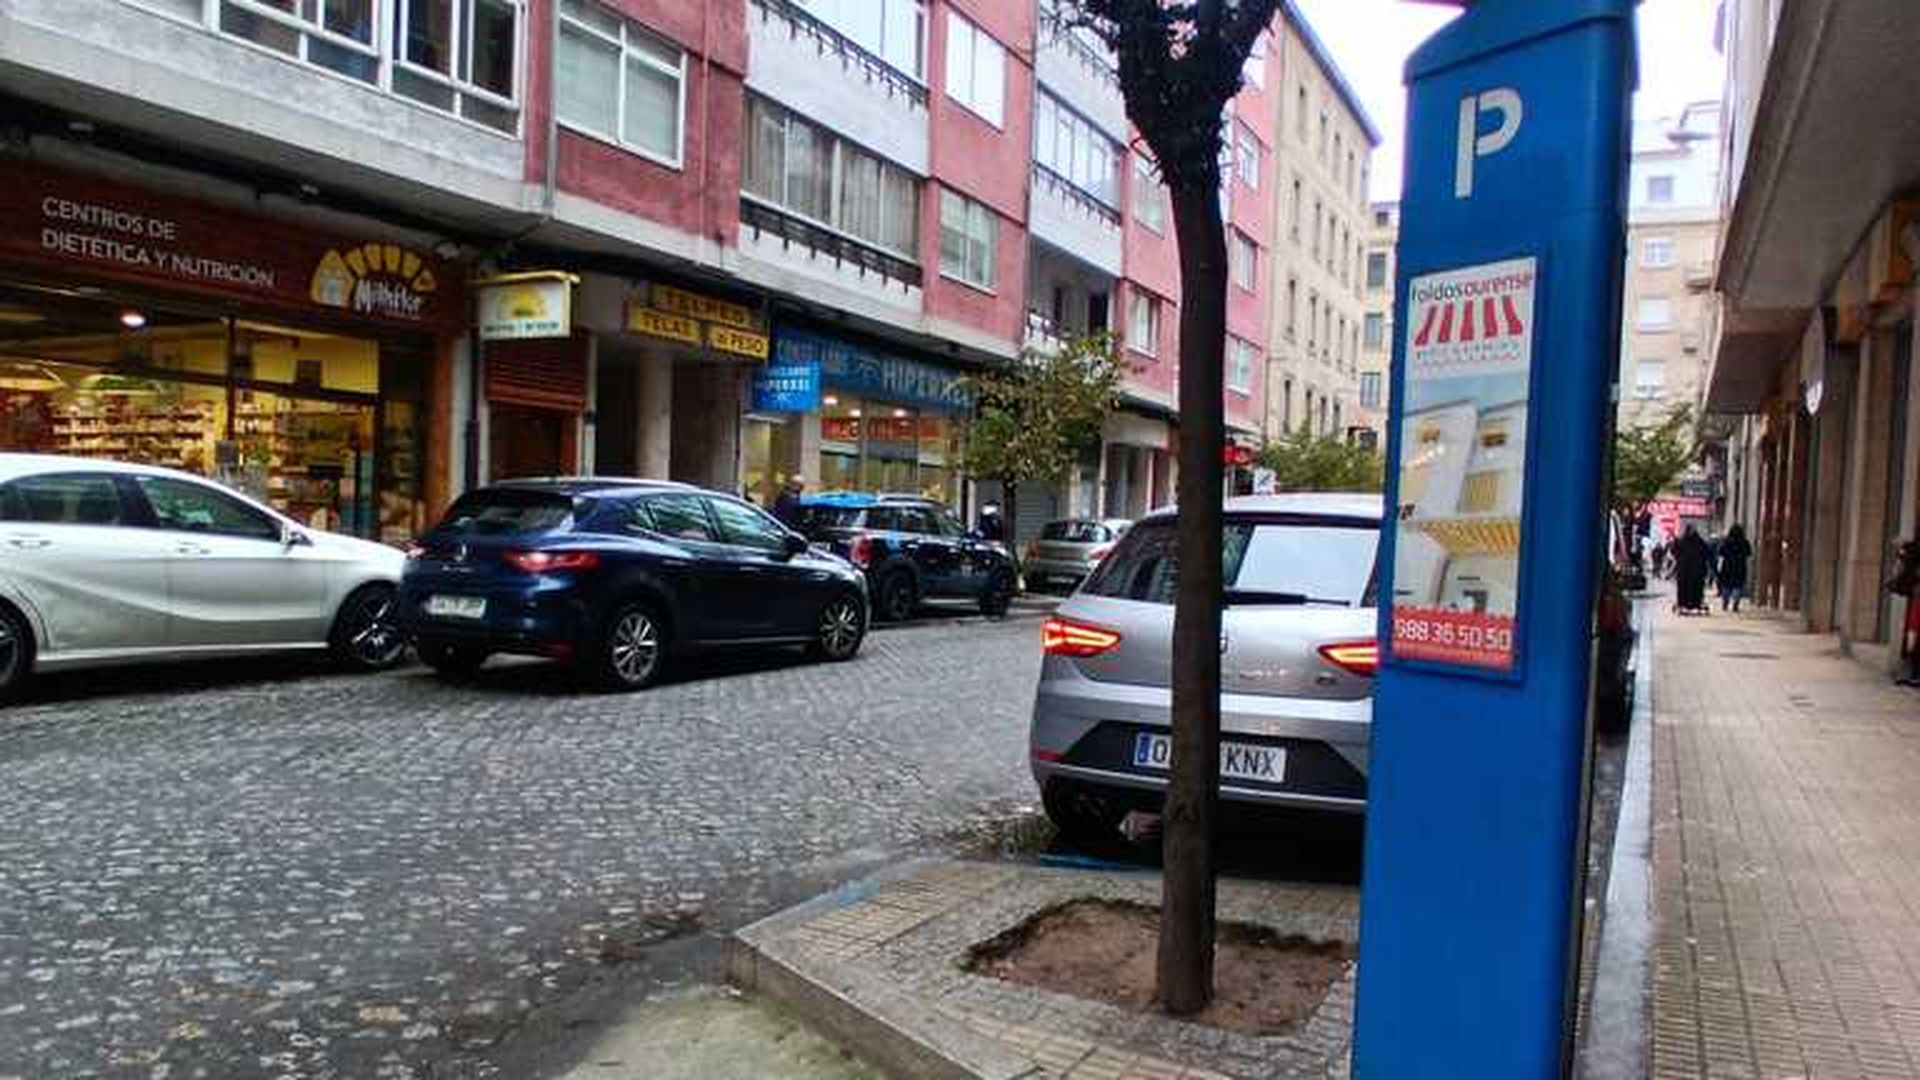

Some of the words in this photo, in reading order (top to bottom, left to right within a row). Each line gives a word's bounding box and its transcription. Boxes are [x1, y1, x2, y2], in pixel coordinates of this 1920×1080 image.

[1454, 87, 1523, 198] P
[42, 197, 143, 235] CENTROS
[149, 221, 178, 240] DE
[152, 251, 167, 268] Y
[1225, 744, 1276, 777] KNX
